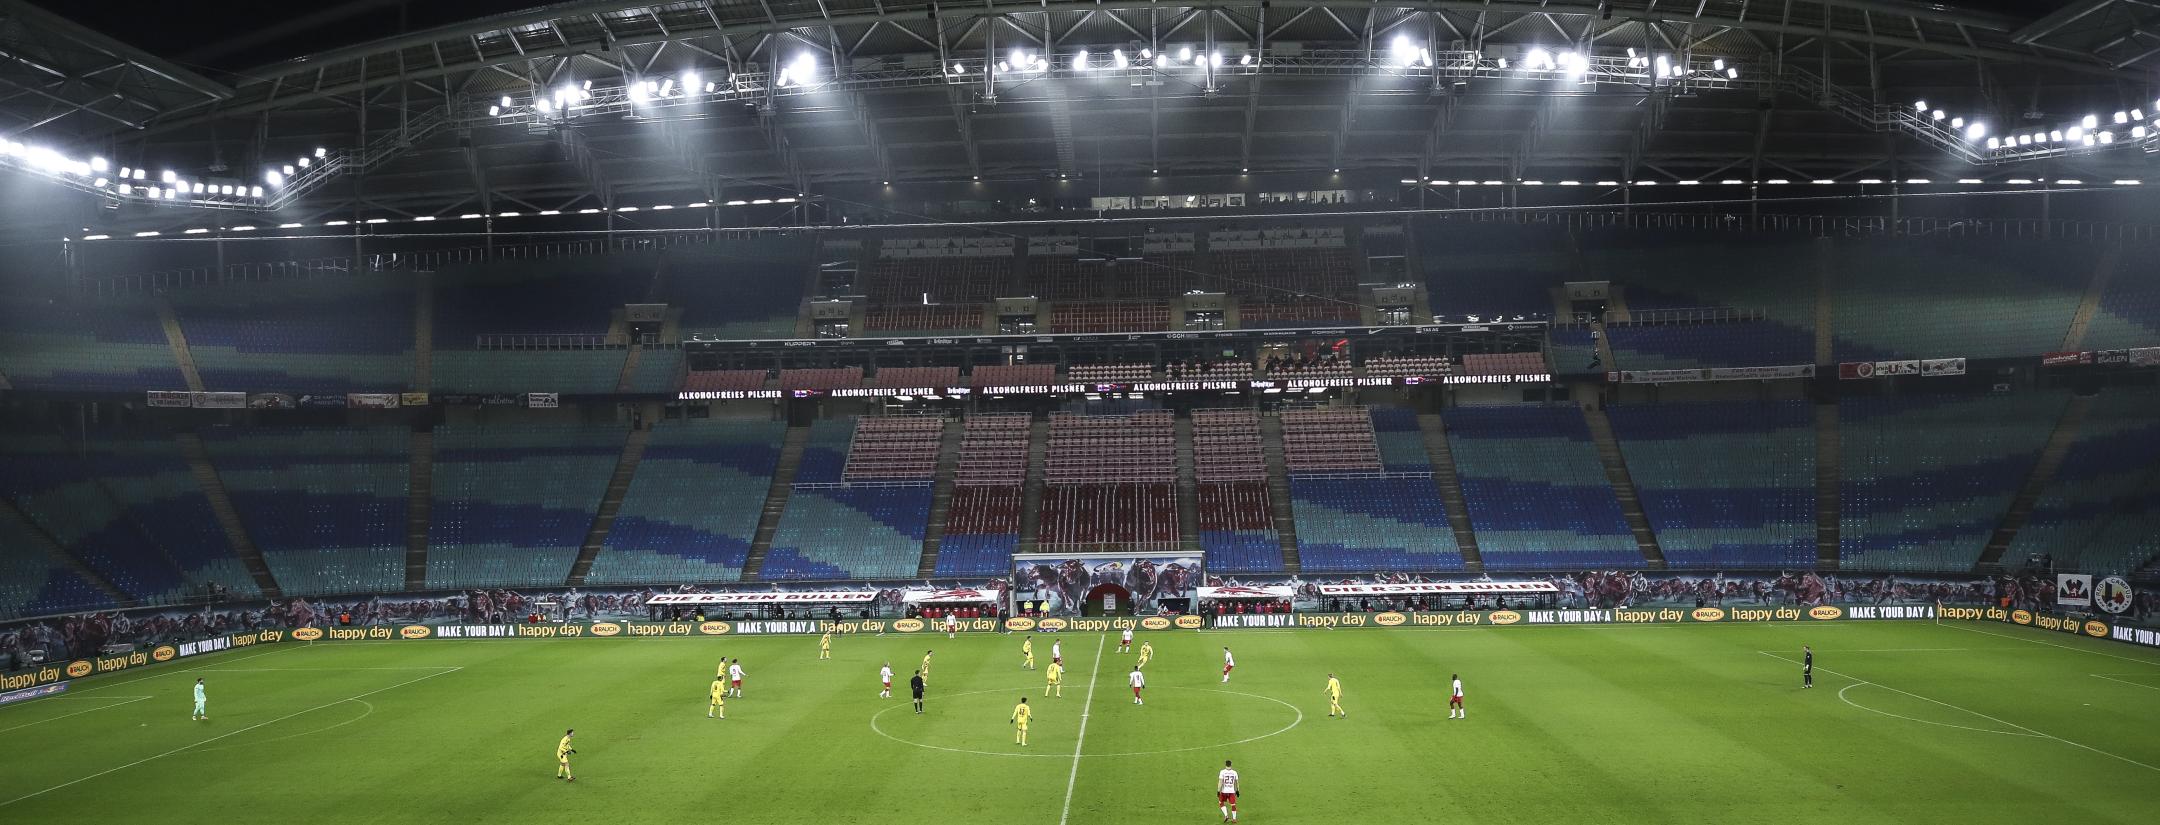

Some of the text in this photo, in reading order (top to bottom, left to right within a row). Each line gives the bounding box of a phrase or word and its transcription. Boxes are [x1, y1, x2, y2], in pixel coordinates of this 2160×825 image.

[1287, 378, 1392, 387] ALKOHOLFREIES PILSNER
[1443, 375, 1511, 384] ALKOHOLFREIES
[1515, 374, 1551, 382] PILSNER
[983, 384, 1085, 394] ALKOHOLFREIES PILSNER
[1133, 383, 1199, 391] ALKOHOLFREIES
[1202, 381, 1237, 389] PILSNER
[678, 390, 782, 399] ALKOHOLFREIES PILSNER
[831, 388, 897, 397] ALKOHOLFREIES
[900, 387, 934, 396] PILSNER
[1460, 582, 1552, 590] BULLEN
[1497, 612, 1517, 621] RAUCH
[1528, 611, 1611, 622] MAKE YOUR DAY A
[1615, 608, 1684, 622] happy day
[1732, 606, 1800, 620] happy day
[1816, 608, 1837, 616] RAUCH
[1849, 606, 1934, 618] MAKE YOUR DAY A
[1939, 606, 2007, 621] happy day
[2017, 613, 2030, 622] RAUCH
[1012, 618, 1032, 626] RAUCH
[1242, 616, 1264, 626] YOUR
[1268, 616, 1287, 626] DAY
[1288, 616, 1294, 626] A
[1299, 613, 1366, 627] happy day
[1382, 614, 1403, 623] RAUCH
[1413, 611, 1481, 625] happy day
[2035, 612, 2080, 633] happy day
[627, 622, 691, 637] happy day
[737, 622, 815, 633] MAKE YOUR DAY A
[861, 620, 885, 632] day
[931, 618, 996, 632] hapy day
[1070, 617, 1137, 631] happy day
[300, 630, 320, 638] RAUCH
[329, 626, 393, 640] happy day
[408, 627, 428, 635] RAUCH
[437, 626, 514, 637] MAKE YOUR DAY A
[519, 624, 583, 638] happy day
[2113, 625, 2132, 640] MAKE
[2135, 630, 2153, 644] YOUR
[232, 629, 283, 646] happy day
[179, 637, 230, 656] MAKE YOUR DAY A
[159, 648, 173, 658] RAUCH
[97, 650, 148, 671] happy day
[73, 663, 91, 674] RAUCH
[0, 666, 60, 690] happy day
[1224, 775, 1234, 785] 23
